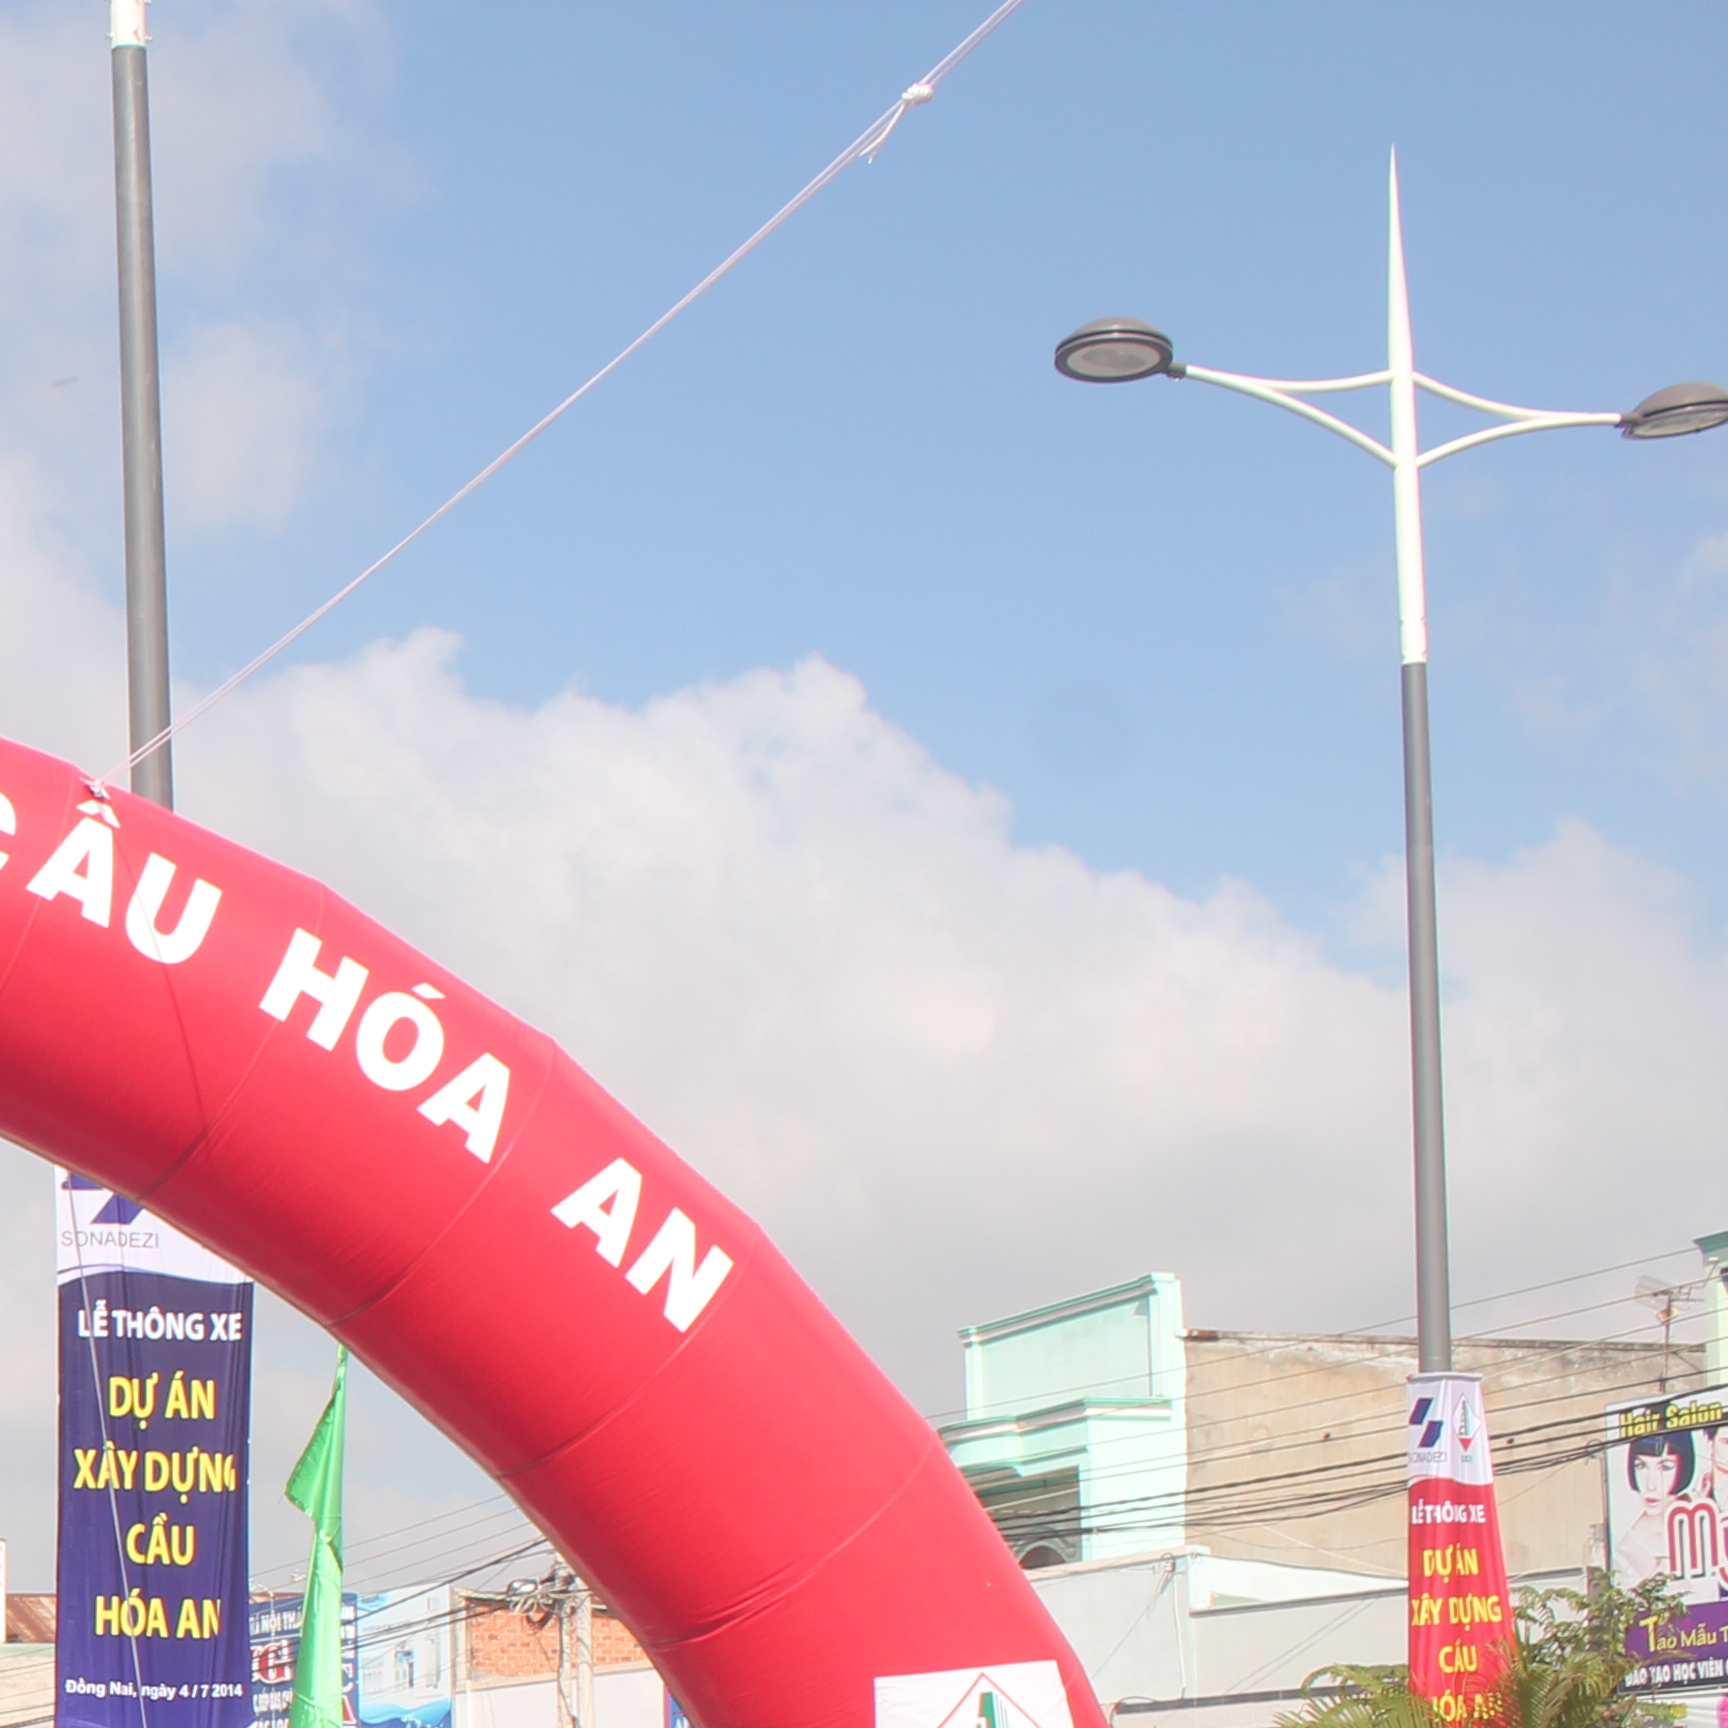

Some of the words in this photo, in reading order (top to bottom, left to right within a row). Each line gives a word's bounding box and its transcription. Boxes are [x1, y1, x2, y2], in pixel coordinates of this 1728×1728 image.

[258, 982, 512, 1164] HÓA
[550, 1157, 735, 1333] AN
[60, 1230, 159, 1248] SONADEZI
[78, 1299, 109, 1338] LỄ
[112, 1306, 204, 1341] THÔNG
[209, 1312, 242, 1342] XE
[109, 1372, 158, 1429] DỰ
[164, 1371, 214, 1419] ÁN
[1620, 1411, 1660, 1439] Hair
[1665, 1400, 1723, 1429] Salon
[73, 1440, 138, 1490] XÂY
[144, 1446, 236, 1504] DỰNG
[126, 1512, 195, 1566] CẦU
[1423, 1544, 1454, 1583] DỰ
[1455, 1542, 1479, 1576] ÁN
[95, 1589, 169, 1638] HÓA
[175, 1598, 221, 1639] AN
[1411, 1596, 1443, 1627] XÂY
[1448, 1593, 1503, 1632] DỰNG
[1681, 1623, 1717, 1648] Mẫu
[65, 1679, 105, 1697] Đồng
[109, 1680, 137, 1698] Nai,
[141, 1683, 175, 1700] ngày
[1673, 1662, 1696, 1685] HỌC
[1697, 1657, 1723, 1679] VIÊN
